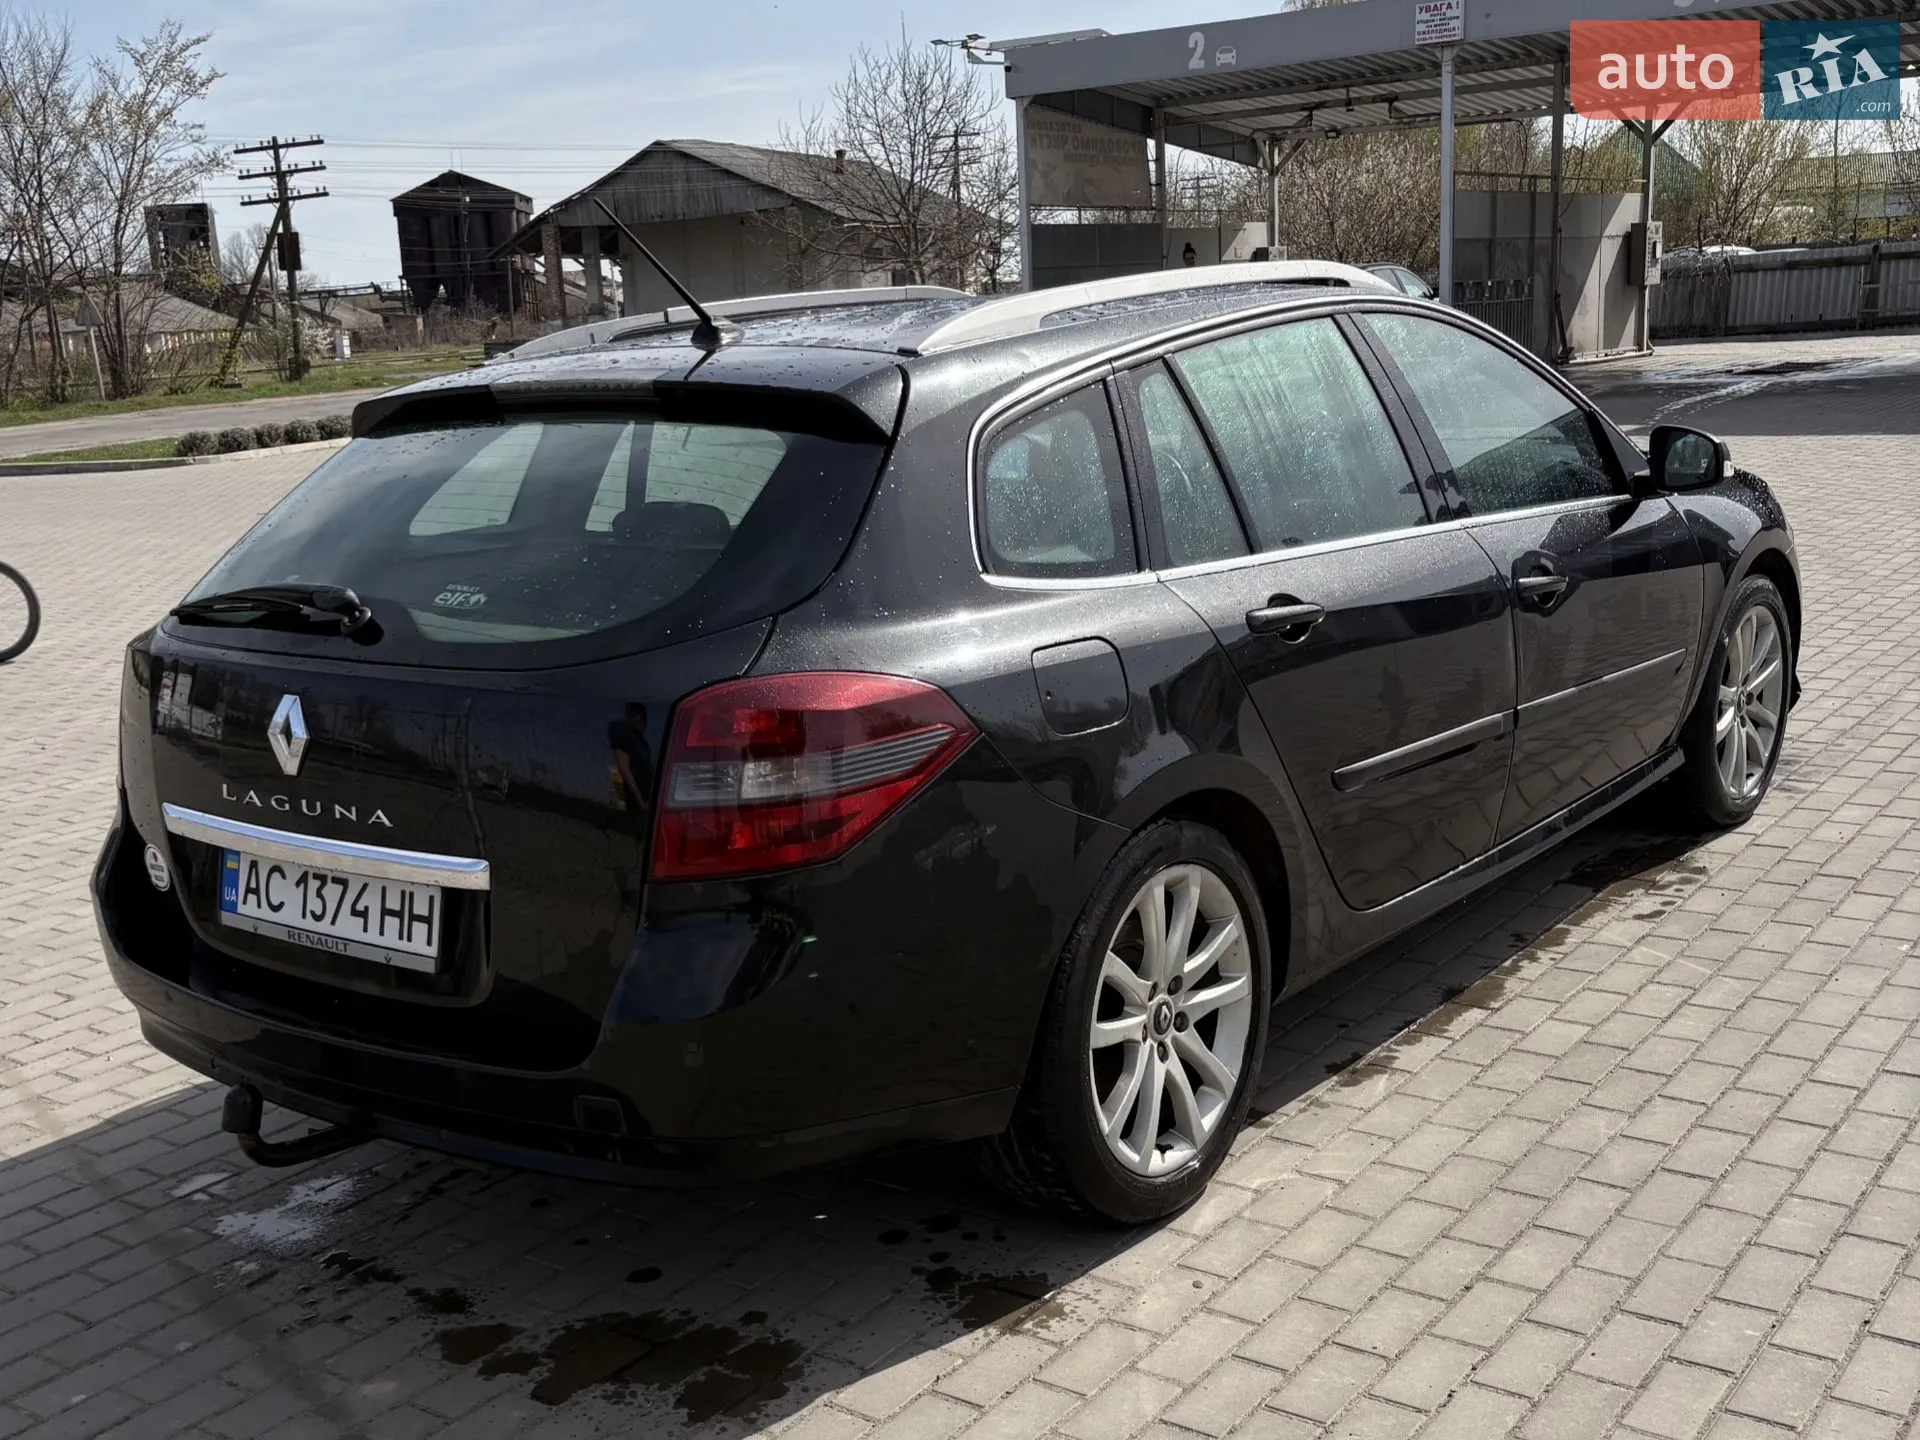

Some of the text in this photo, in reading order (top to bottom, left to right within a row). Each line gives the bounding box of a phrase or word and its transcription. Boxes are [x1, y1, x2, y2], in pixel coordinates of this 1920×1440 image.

[1418, 2, 1453, 14] УВАГА
[1188, 31, 1205, 69] 2
[434, 592, 471, 606] elf
[222, 783, 394, 827] LAGUNA
[224, 886, 237, 902] UA
[242, 860, 435, 946] AC 1374 HH
[287, 929, 350, 953] RENAULT
